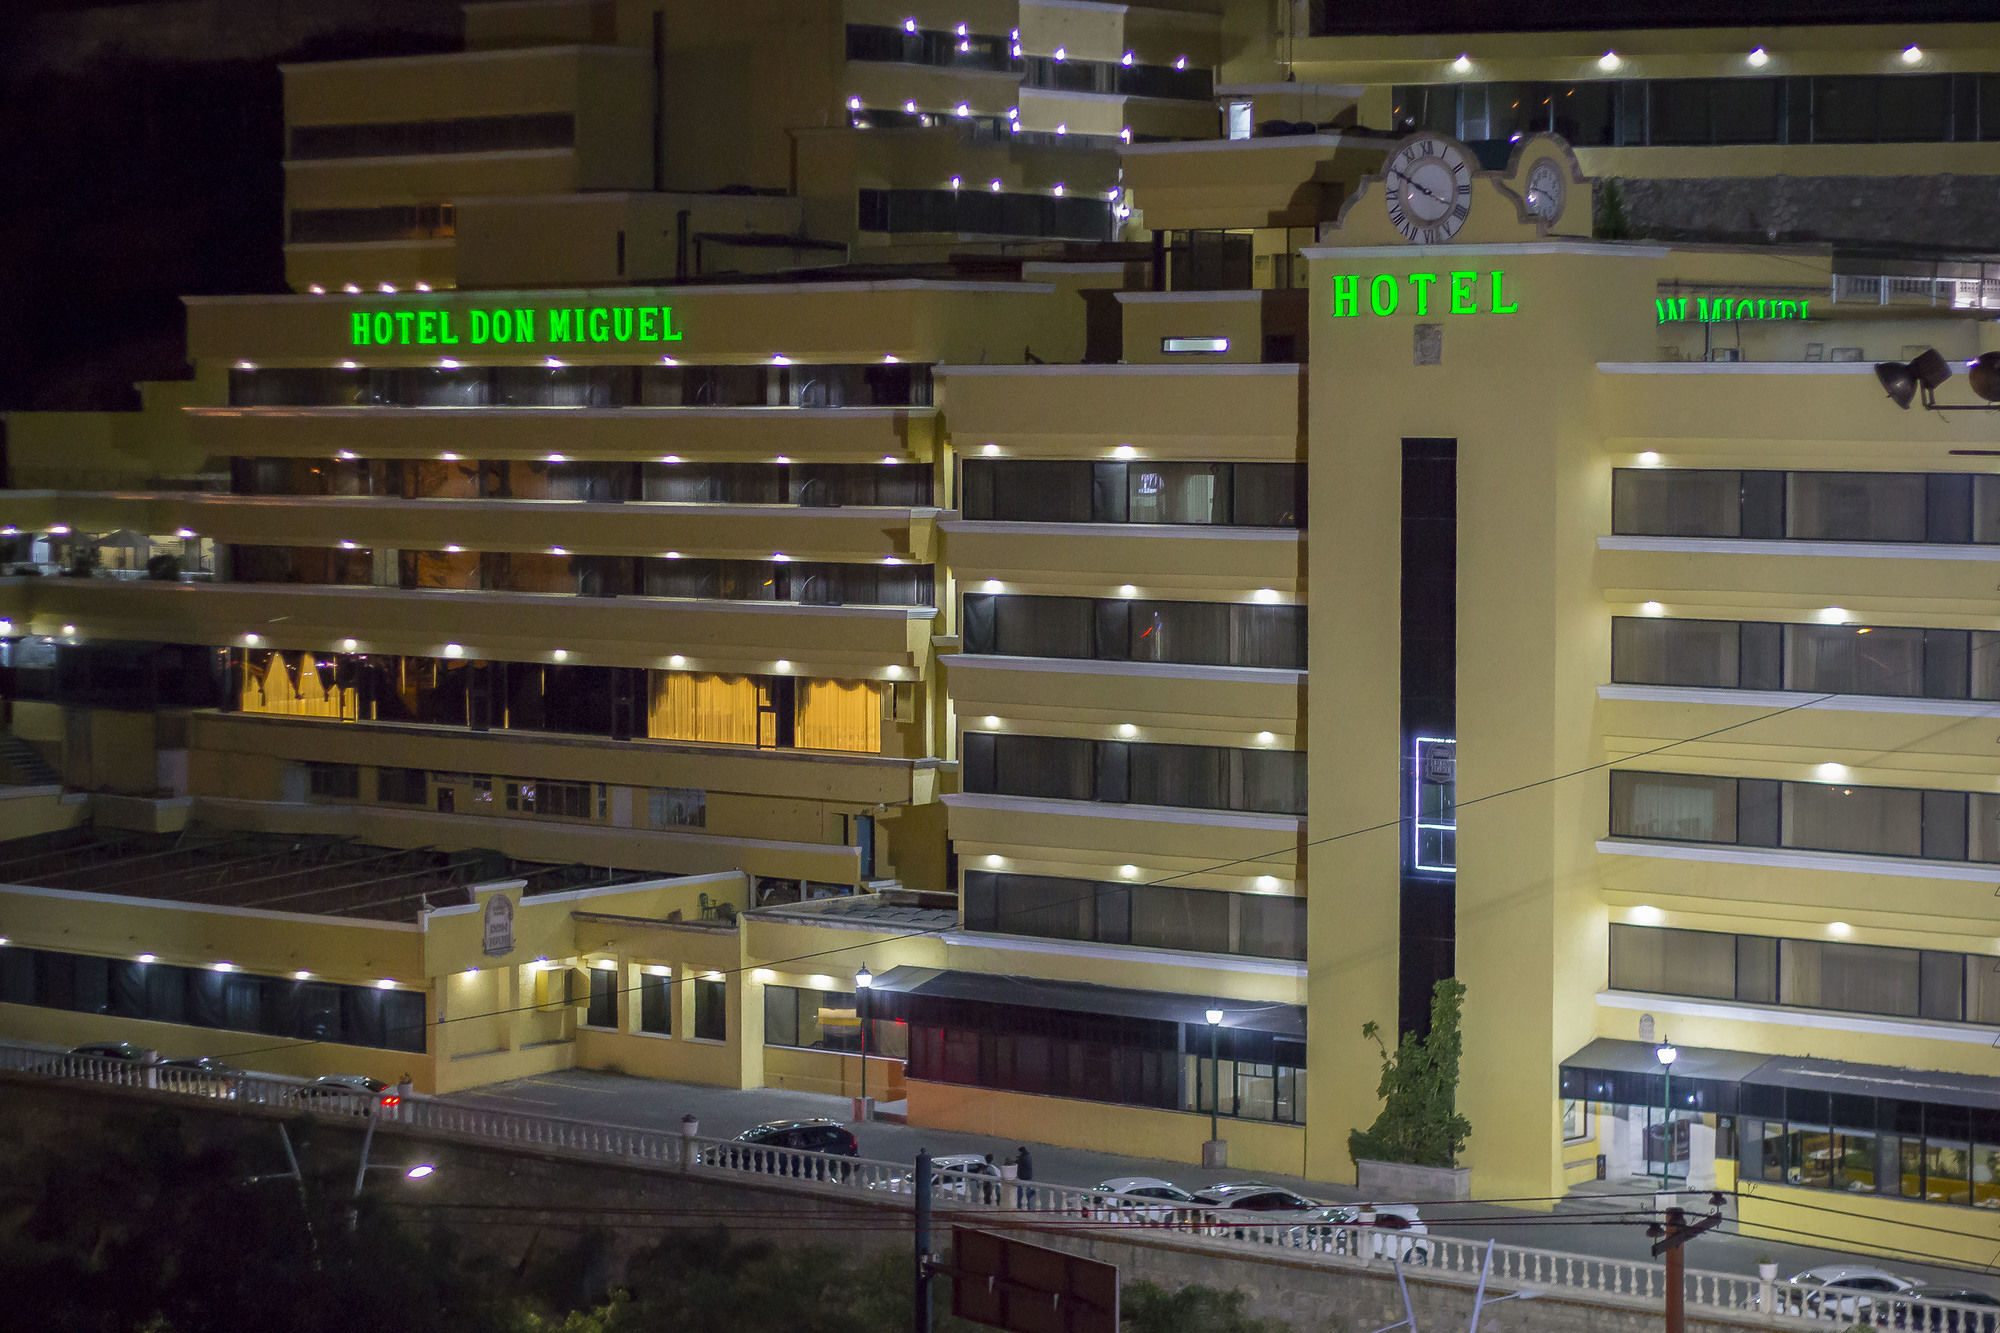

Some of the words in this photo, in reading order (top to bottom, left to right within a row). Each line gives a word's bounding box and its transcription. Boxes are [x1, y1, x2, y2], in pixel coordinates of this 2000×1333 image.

[1452, 161, 1465, 174] II
[1458, 184, 1470, 194] III
[1389, 204, 1406, 226] VIII
[1400, 222, 1418, 241] VII
[1332, 270, 1519, 317] HOTEL
[351, 311, 459, 345] HOTEL
[469, 308, 535, 344] DON
[549, 307, 683, 343] MIGUEL
